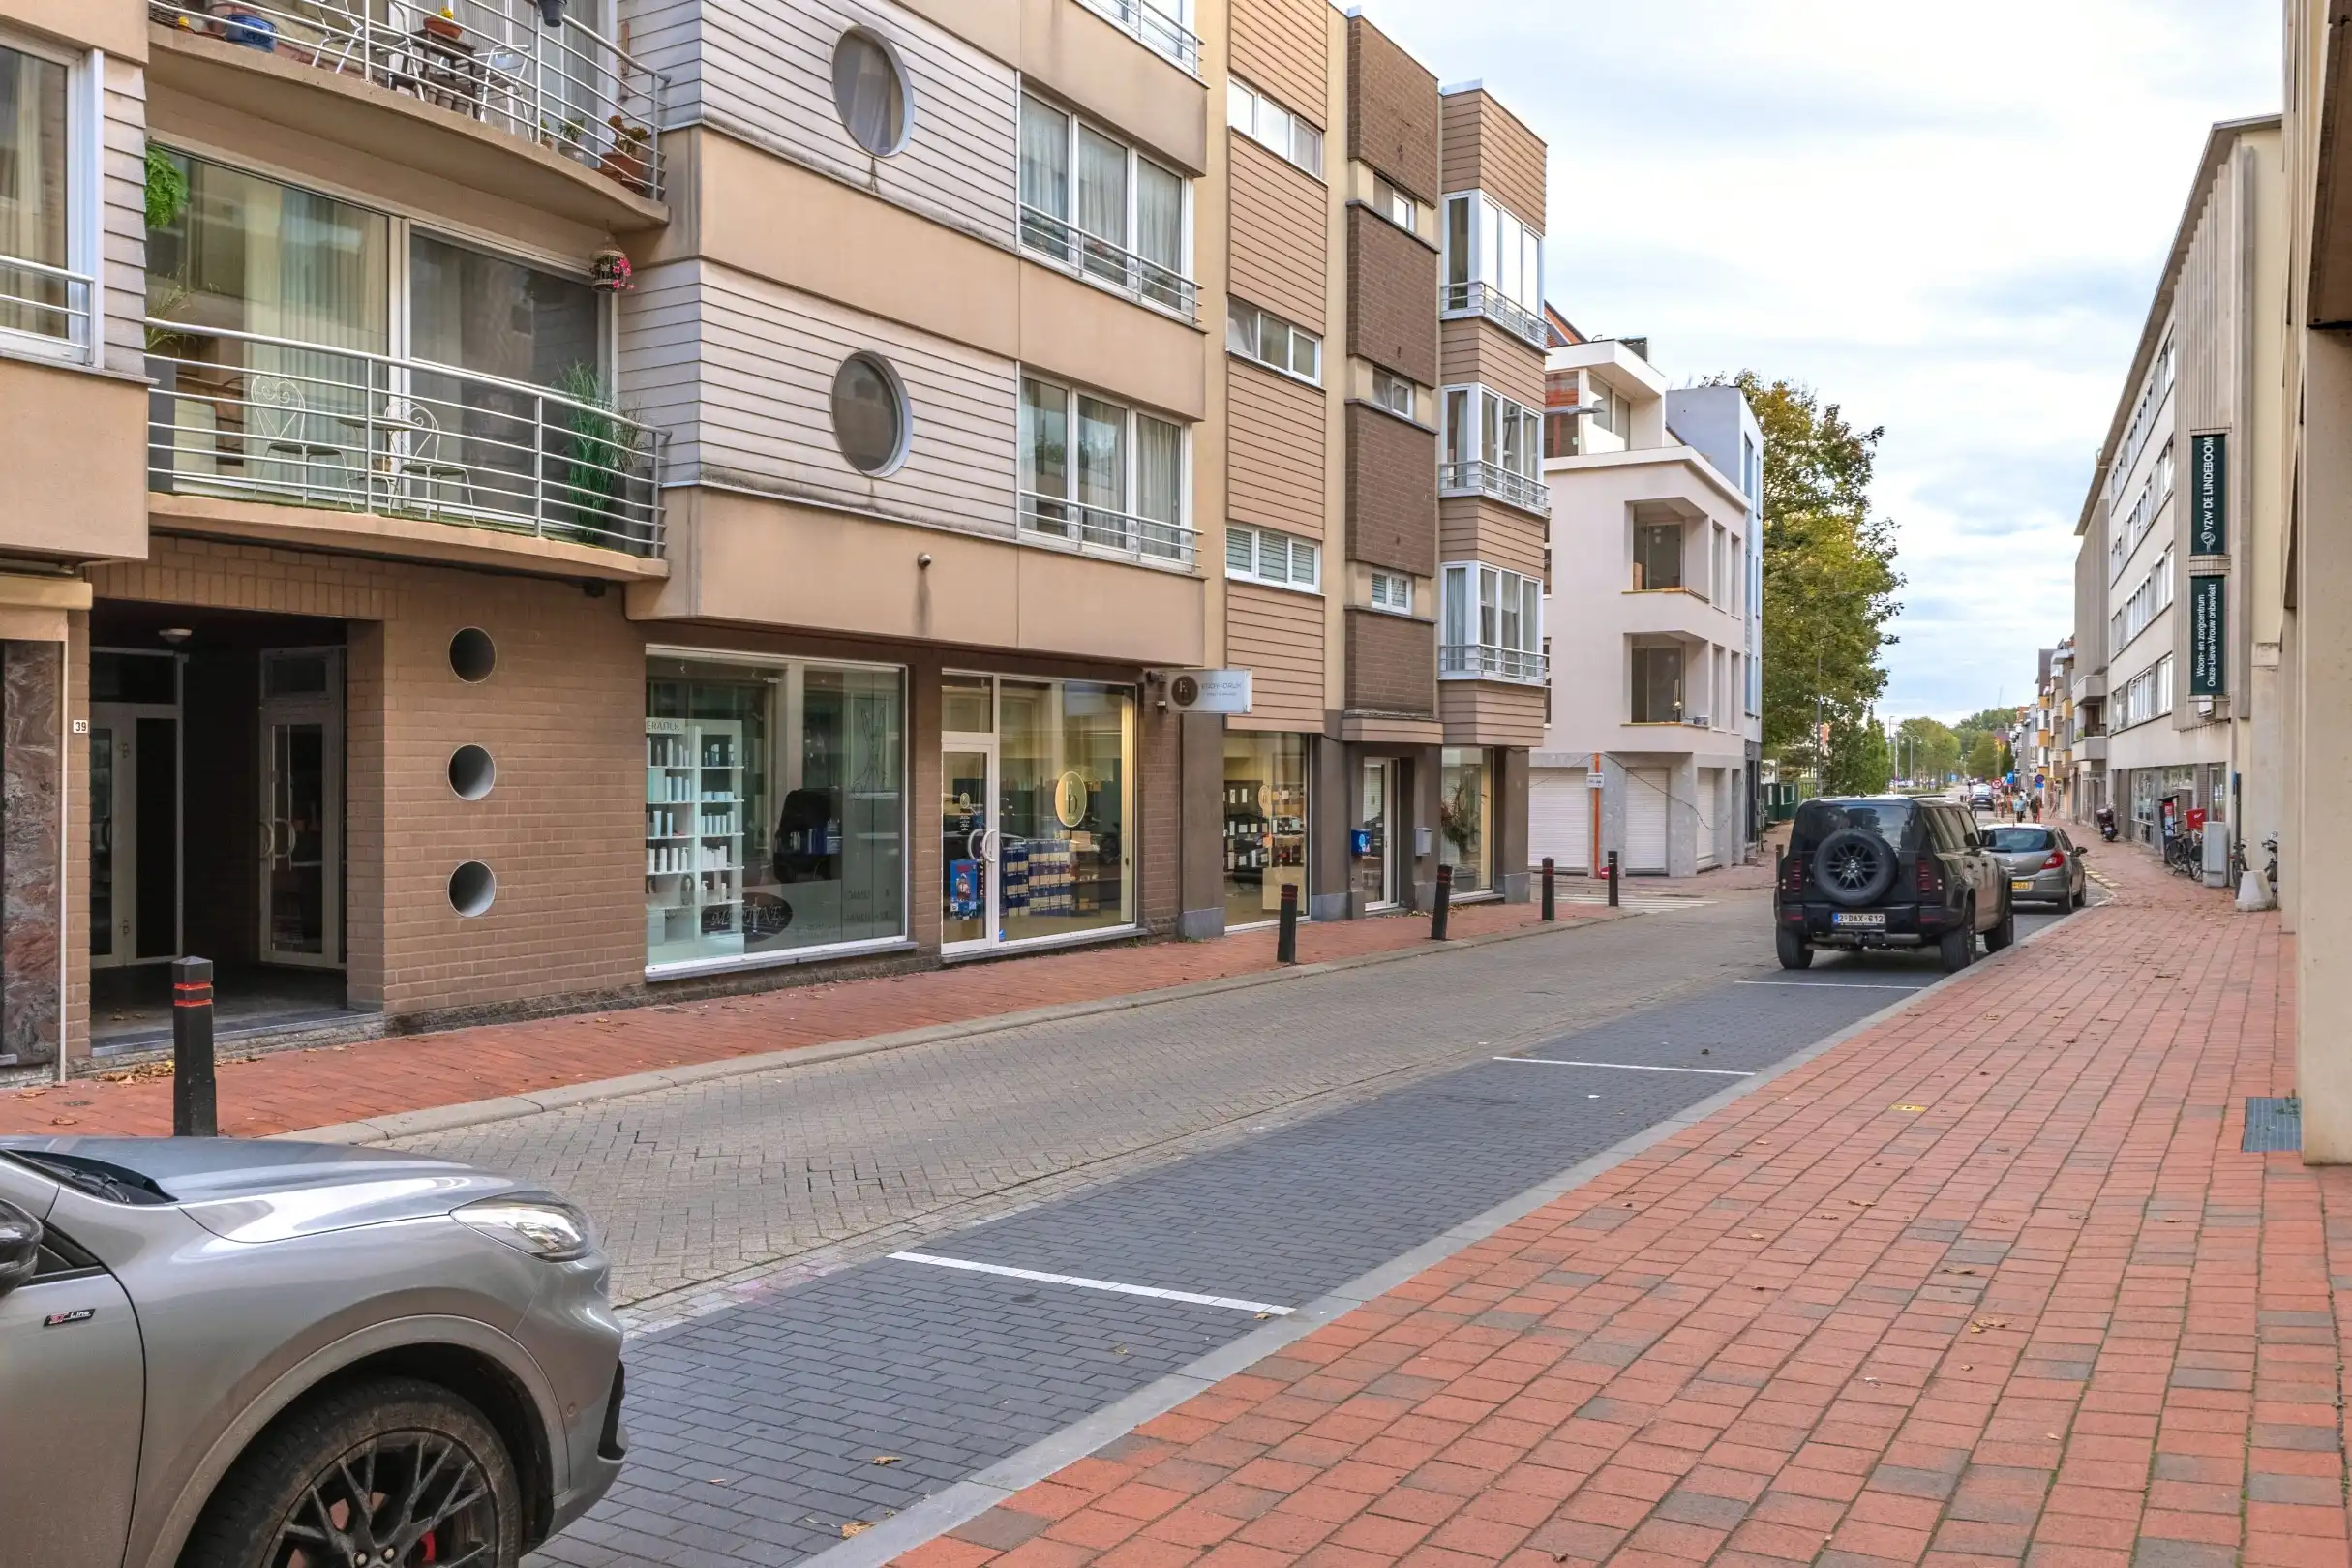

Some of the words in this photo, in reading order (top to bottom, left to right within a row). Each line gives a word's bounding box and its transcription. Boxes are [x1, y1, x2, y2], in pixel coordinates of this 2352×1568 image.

[2203, 437, 2214, 495] LINDEBOOM
[2203, 497, 2214, 509] DE
[2203, 510, 2214, 531] VZW
[2207, 584, 2216, 618] onbevlekt
[2197, 594, 2207, 640] zorgcentrum
[2198, 641, 2205, 651] en
[2207, 620, 2216, 687] Onze-Lieve-Vrouw
[2196, 652, 2205, 678] Woon-
[75, 721, 87, 732] 39
[70, 1311, 90, 1319] Line
